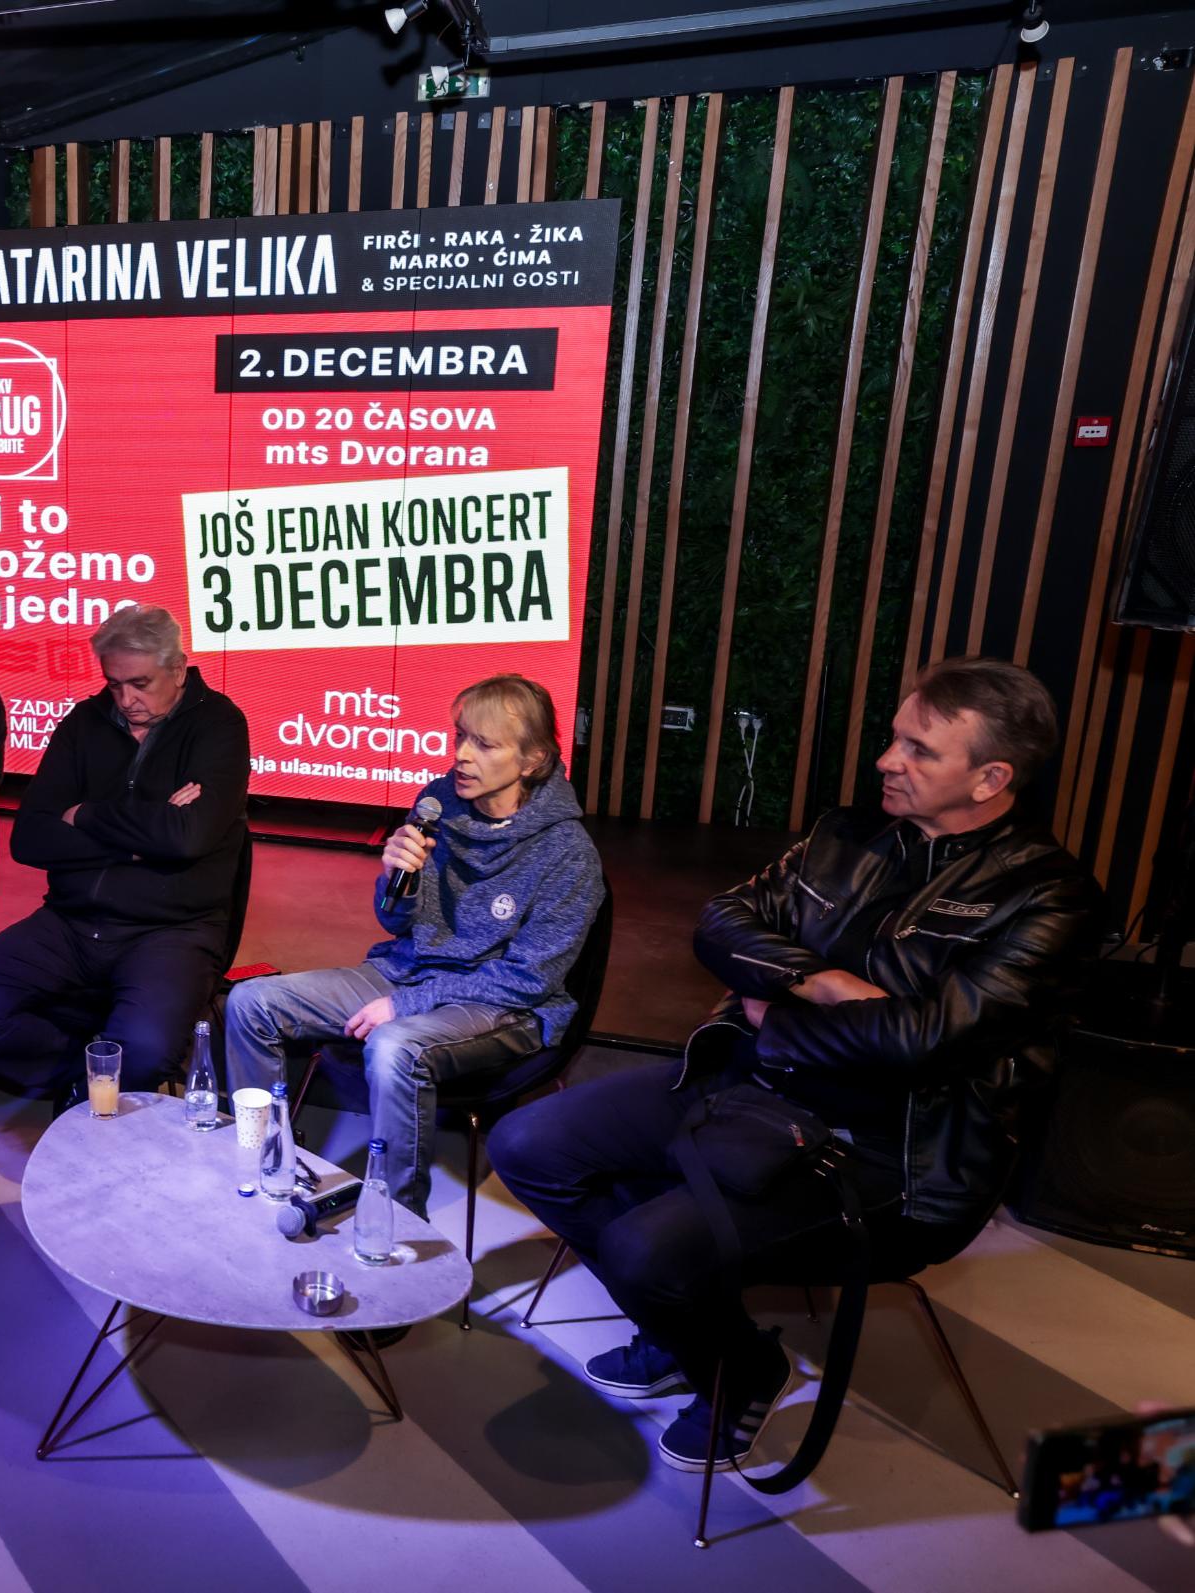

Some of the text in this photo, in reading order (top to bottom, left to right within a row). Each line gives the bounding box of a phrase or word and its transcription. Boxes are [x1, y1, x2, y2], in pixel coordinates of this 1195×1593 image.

[363, 224, 584, 250] FIRČI RAKA ŽIKA
[176, 234, 337, 299] VELIKA
[389, 247, 552, 270] MARKO ĆIMA
[361, 270, 580, 292] & SPECIJALNI GOSTI
[262, 402, 496, 431] OD 20 ČASOVA
[265, 441, 489, 467] mts Dvorana
[18, 499, 69, 534] to
[199, 490, 552, 559] JOŠ JEDAN KONCERT
[324, 687, 401, 719] mts
[278, 713, 448, 756] dvorana
[280, 758, 367, 780] ulaznica
